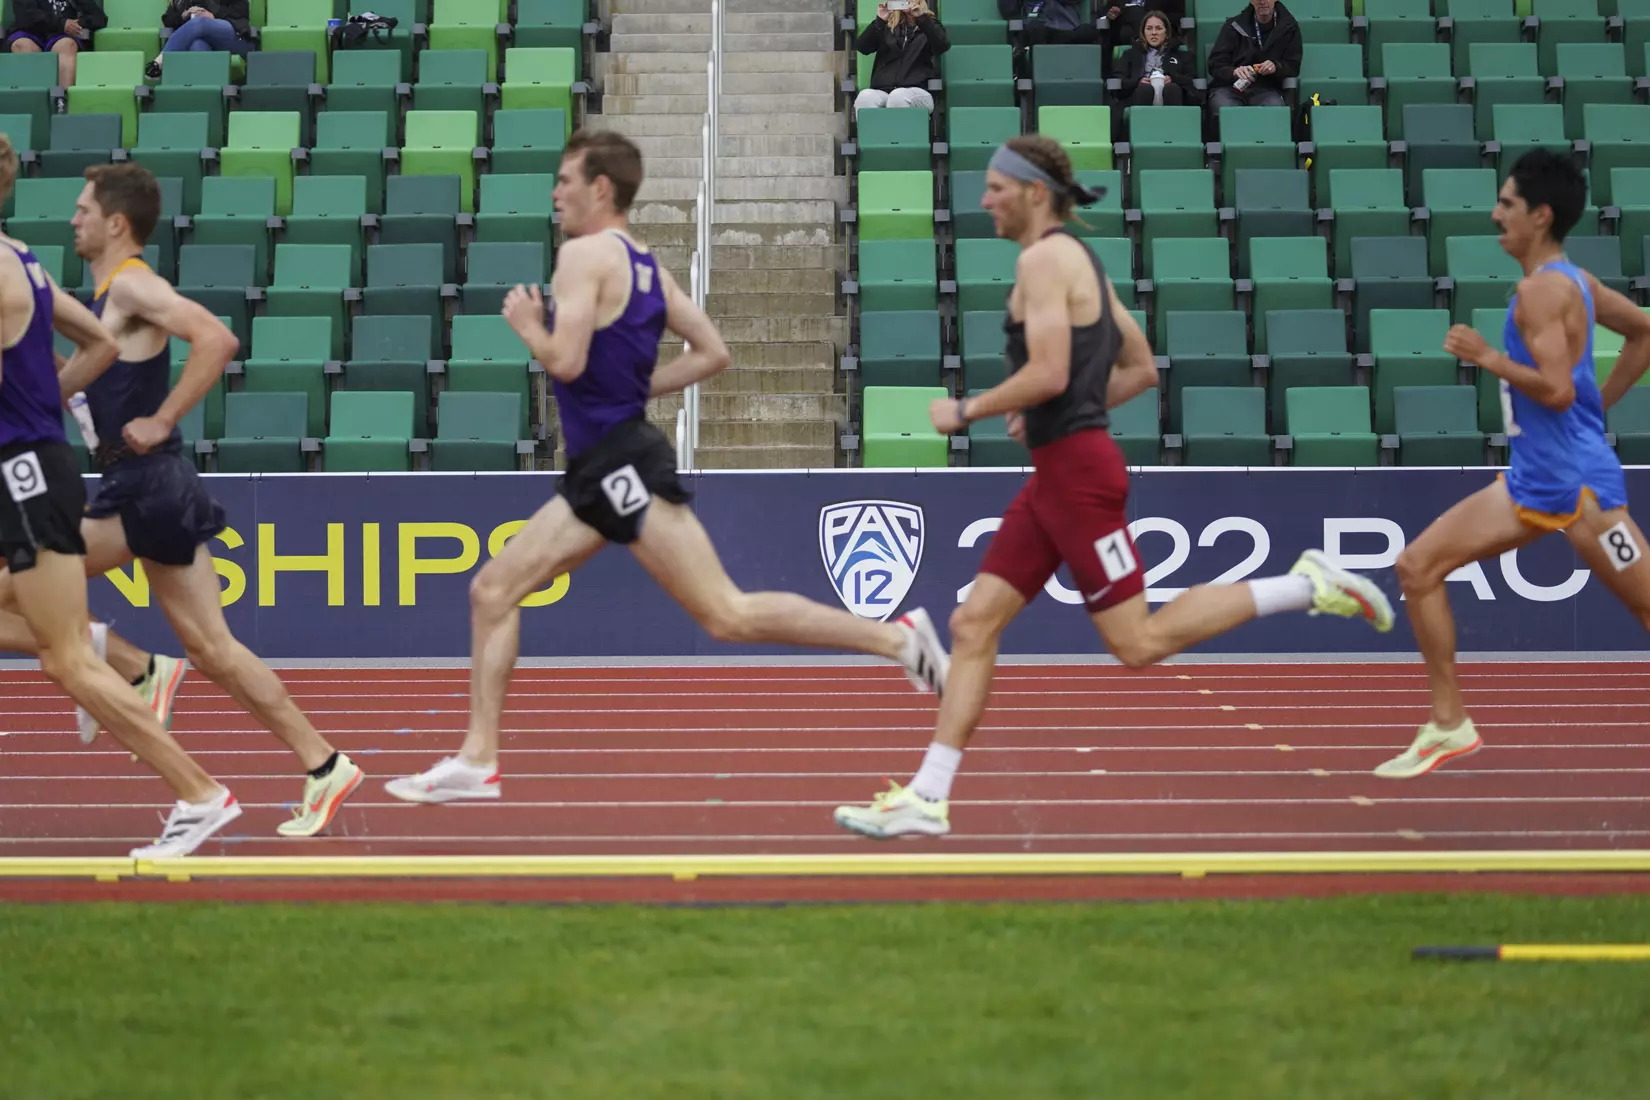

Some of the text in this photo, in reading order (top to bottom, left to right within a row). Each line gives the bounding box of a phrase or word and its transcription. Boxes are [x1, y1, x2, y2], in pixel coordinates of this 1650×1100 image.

[12, 459, 38, 493] 9
[610, 475, 642, 511] 2
[824, 505, 919, 578] PAC
[1107, 539, 1127, 570] 1
[1608, 530, 1635, 563] 8
[854, 569, 893, 605] 12
